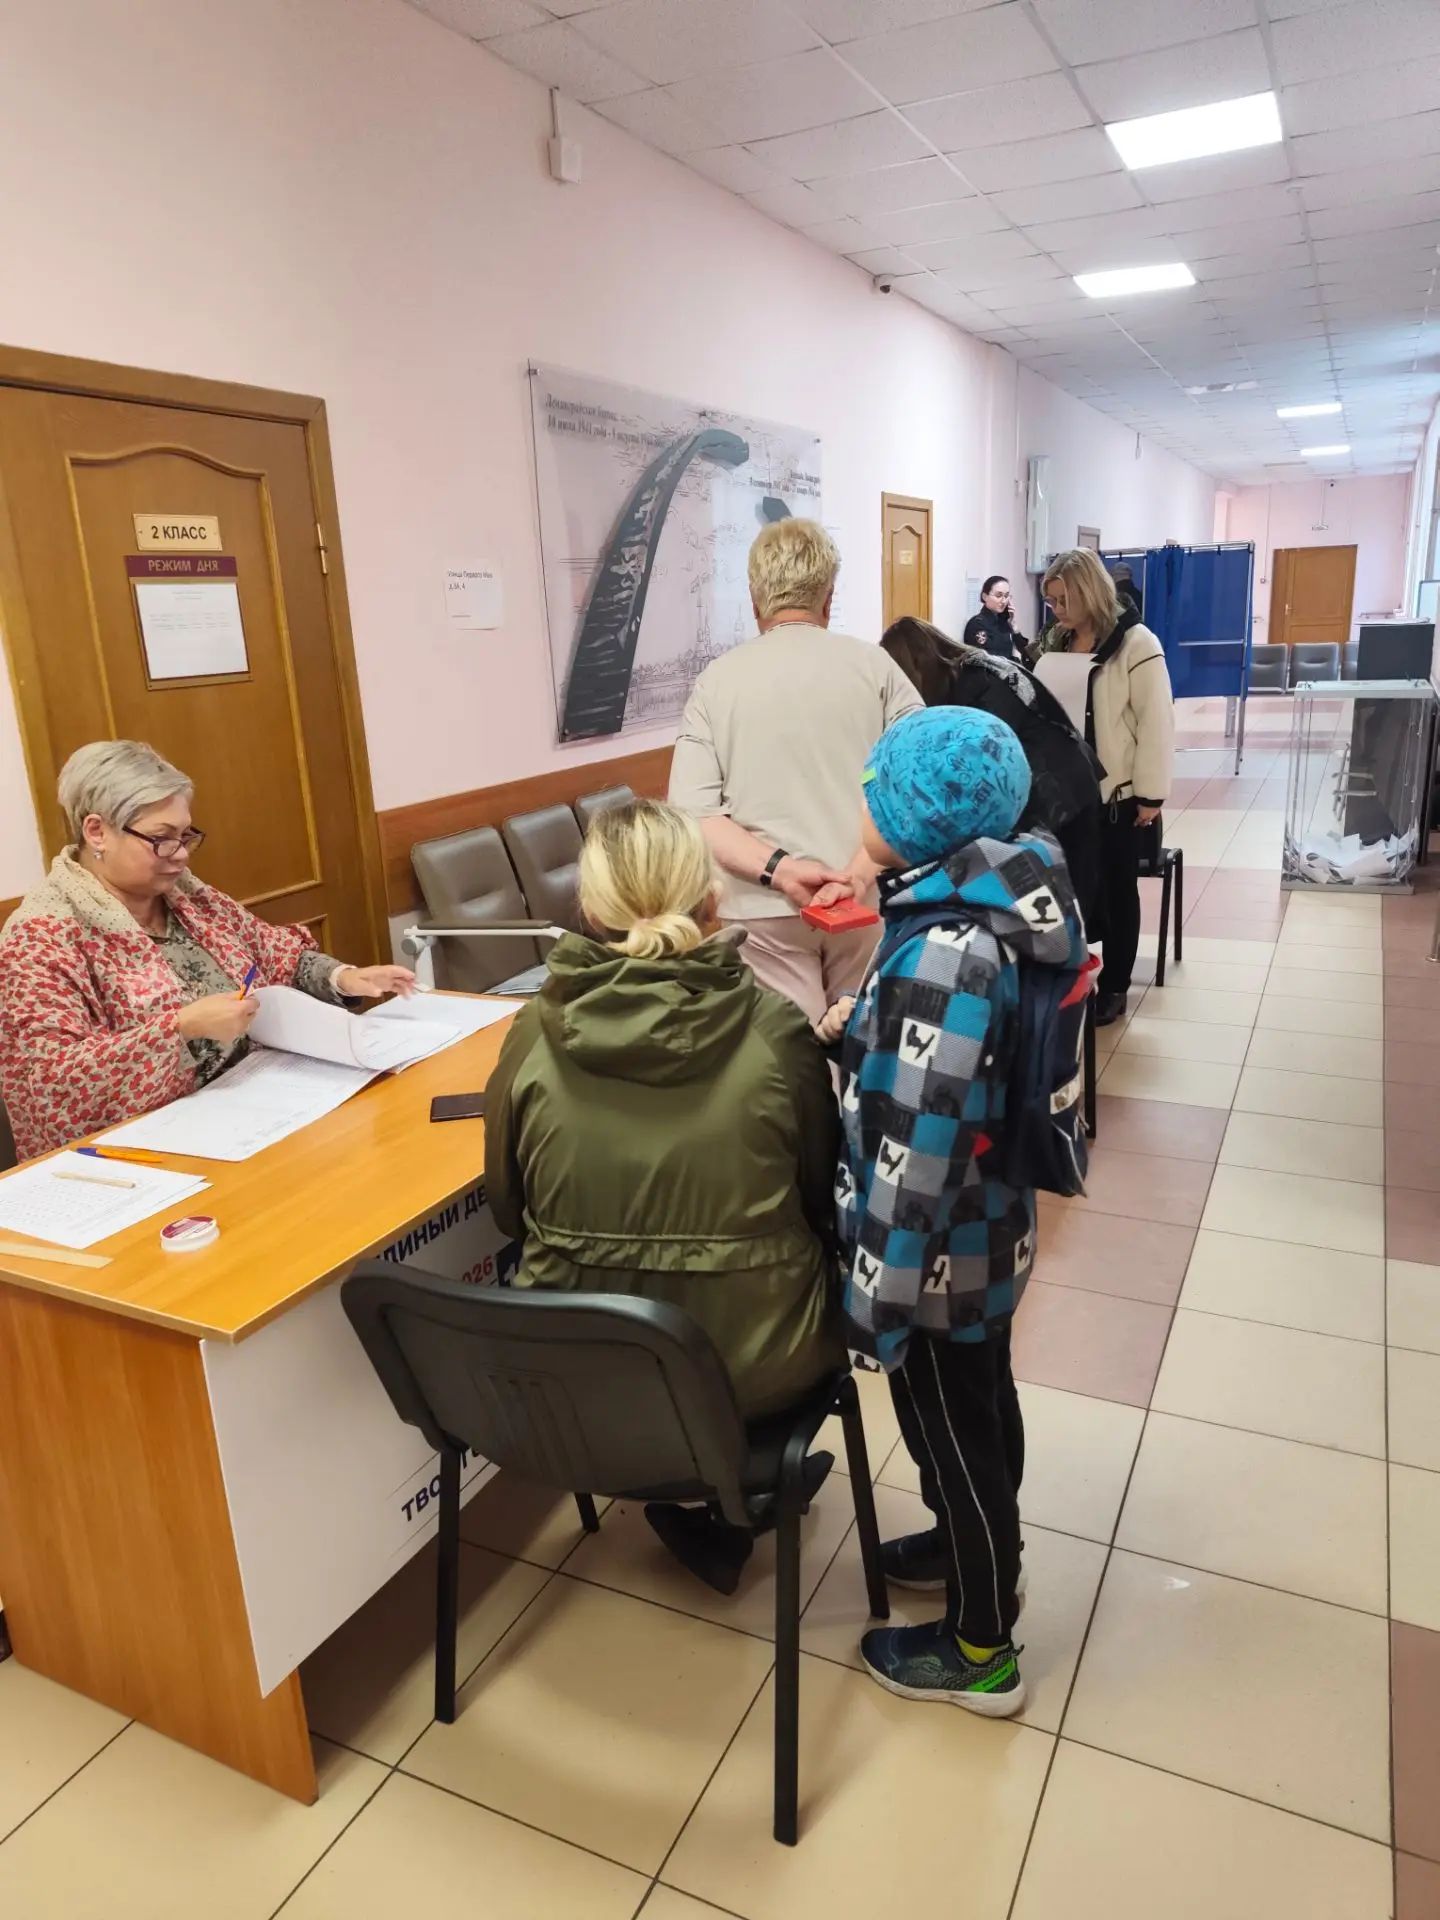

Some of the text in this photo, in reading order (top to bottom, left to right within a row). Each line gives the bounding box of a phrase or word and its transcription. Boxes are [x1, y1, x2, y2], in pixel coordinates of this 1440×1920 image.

[151, 525, 207, 540] 2 КЛАСС
[148, 559, 219, 573] РЕЖИМ ДНЯ
[463, 1184, 488, 1220] ДЕ
[462, 1255, 493, 1285] 026
[401, 1474, 441, 1521] ТВО
